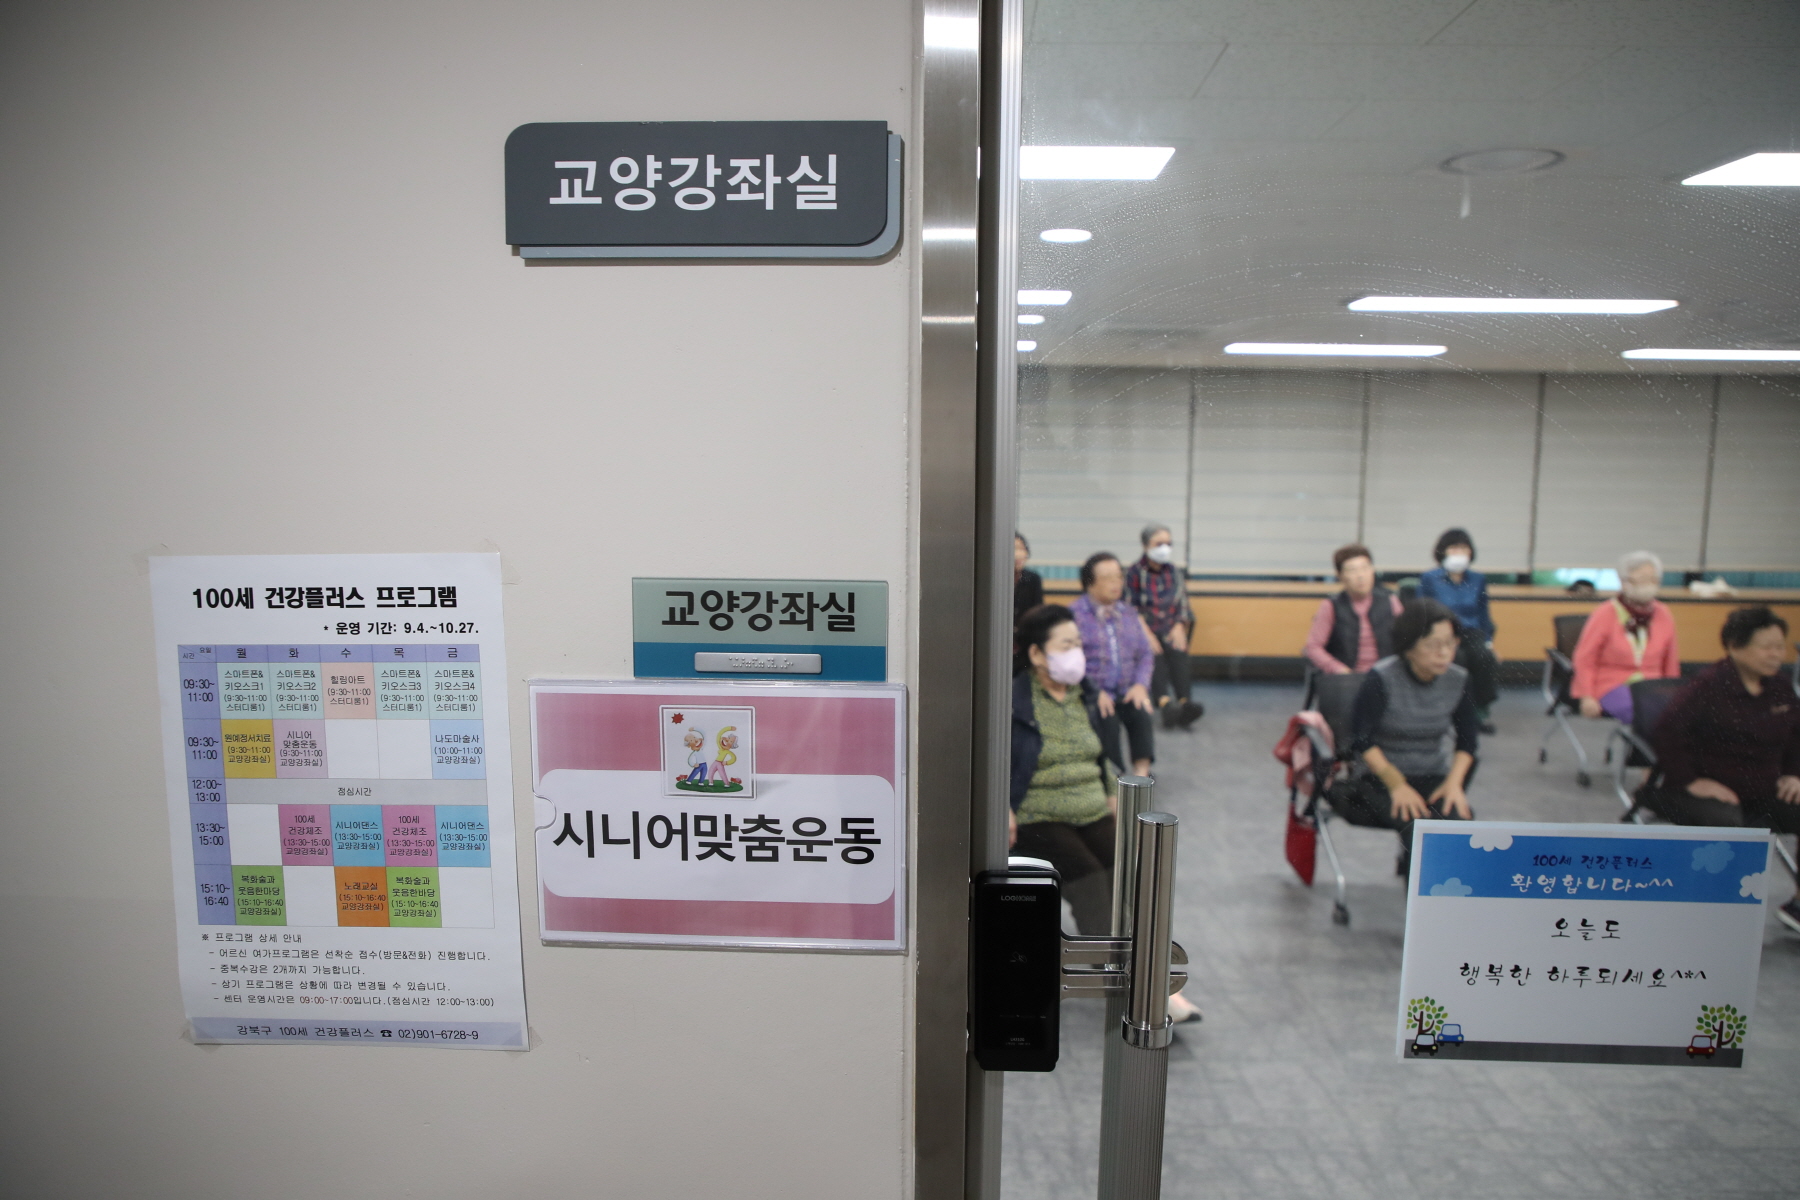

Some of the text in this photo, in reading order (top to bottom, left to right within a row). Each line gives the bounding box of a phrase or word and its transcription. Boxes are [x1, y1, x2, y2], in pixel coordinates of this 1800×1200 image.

[549, 154, 838, 211] 교양강좌실
[193, 586, 457, 609] 100세 건강플러스 프로그램
[662, 590, 856, 632] 교양강좌실
[336, 622, 361, 635] 운영
[368, 622, 397, 635] 기간:
[404, 623, 479, 634] 9.4.~10.27.
[237, 648, 246, 658] 월
[289, 648, 299, 658] 화
[341, 648, 351, 658] 수
[394, 648, 404, 658] 목
[448, 648, 457, 658] 금
[225, 670, 263, 678] 스마트폰&
[277, 670, 315, 678] 스마트폰&
[381, 670, 420, 678] 스마트폰&
[434, 670, 474, 678] 스마트폰&
[184, 679, 215, 689] 09:30~
[331, 676, 365, 684] 힐링아트
[225, 682, 263, 690] 키오스크1
[277, 682, 316, 690] 키오스크2
[382, 682, 421, 690] 키오스크3
[435, 682, 475, 690] 키오스크4
[327, 688, 371, 696] (9:30~11:00
[188, 693, 213, 702] 11:00
[224, 694, 267, 702] (9:30~11:00
[276, 694, 319, 702] (9:30~11:00
[381, 694, 424, 702] (9:30~11:00
[434, 694, 478, 702] (9:30~11:00
[225, 734, 271, 742] 원예정서치료
[287, 731, 312, 739] 시니어
[436, 735, 479, 743] 나도마술사
[188, 737, 219, 746] 09:30~
[283, 741, 317, 749] 맞춤운동
[228, 746, 270, 754] (9:30~11:00
[192, 750, 217, 759] 11:00
[281, 759, 322, 767] 교양강좌실)
[192, 780, 222, 789] 12:00~
[338, 788, 371, 796] 점심시간
[196, 792, 220, 802] 13:00
[294, 815, 315, 823] 100세
[398, 816, 419, 824] 100세
[196, 823, 225, 832] 13:30~
[336, 822, 378, 830] 시니어댄스
[441, 822, 484, 830] 시니어댄스
[288, 827, 322, 835] 건강체조
[392, 828, 427, 836] 건강체조
[199, 836, 224, 845] 15:00
[334, 833, 382, 841] (13:30~15:00
[552, 810, 882, 865] 시니어맞춤운동
[337, 842, 380, 850] 교양강좌실)
[442, 843, 485, 851] 교양강좌실)
[1532, 854, 1652, 870] 100세 건강플러스
[345, 882, 378, 890] 노래교실
[204, 897, 228, 906] 16:40
[240, 908, 281, 916] 교양강좌실)
[393, 909, 436, 917] 교양강좌실)
[1551, 918, 1621, 941] 오늘도
[216, 933, 253, 942] 프로그램
[259, 934, 277, 942] 상세
[283, 934, 302, 943] 안내
[220, 949, 247, 958] 어르신
[253, 949, 319, 959] 여가프로그램은
[325, 950, 353, 959] 선착순
[359, 950, 431, 960] 접수(방문&전화)
[438, 951, 490, 960] 진행합니다.
[221, 964, 268, 974] 중복수강은
[273, 965, 306, 974] 2개까지
[313, 966, 365, 975] 가능합니다.
[1459, 962, 1532, 987] 행복한
[222, 980, 240, 988] 상기
[246, 980, 294, 989] 프로그램은
[300, 981, 328, 990] 상황에
[334, 982, 352, 990] 따라
[358, 982, 386, 990] 변경될
[393, 982, 401, 990] 수
[408, 982, 450, 991] 있습니다.
[224, 995, 242, 1003] 센터
[248, 995, 294, 1004] 운영시간은
[437, 998, 494, 1006] 12:00~13:00)
[237, 1026, 478, 1039] 강북구 100세 건강플러스 02)901-6728~9
